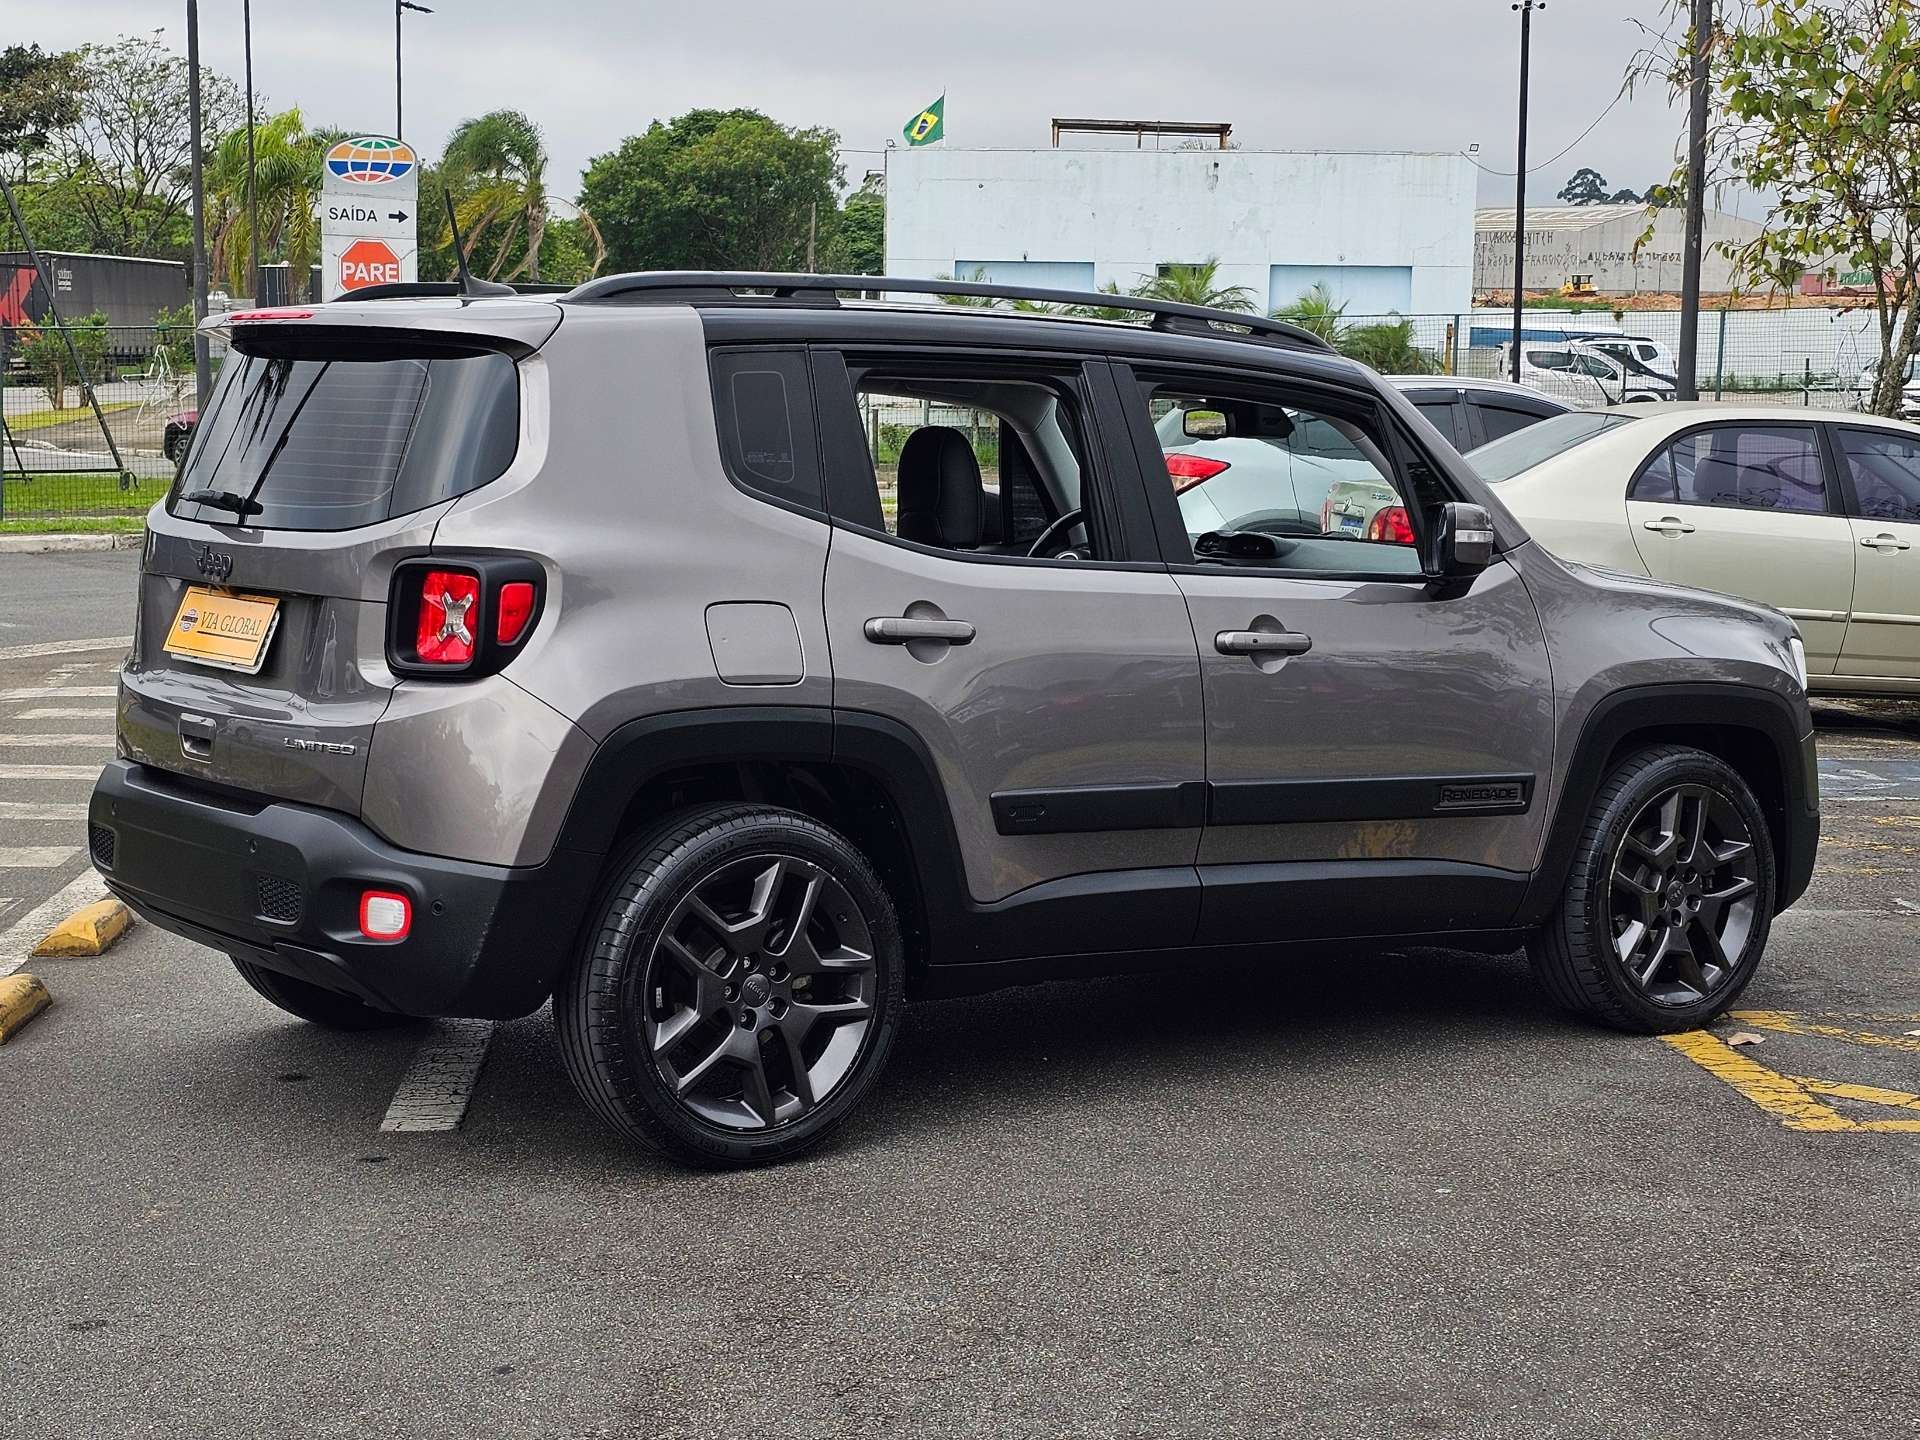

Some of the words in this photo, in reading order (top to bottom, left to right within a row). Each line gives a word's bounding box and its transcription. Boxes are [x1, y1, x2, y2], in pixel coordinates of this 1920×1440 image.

[329, 205, 377, 222] SAÍDA
[342, 262, 398, 282] PARE
[197, 545, 233, 582] Jeep
[201, 611, 220, 630] VIA
[220, 615, 262, 636] GLOBAL
[283, 737, 356, 755] LIMITED
[1441, 787, 1519, 802] RENEGADE
